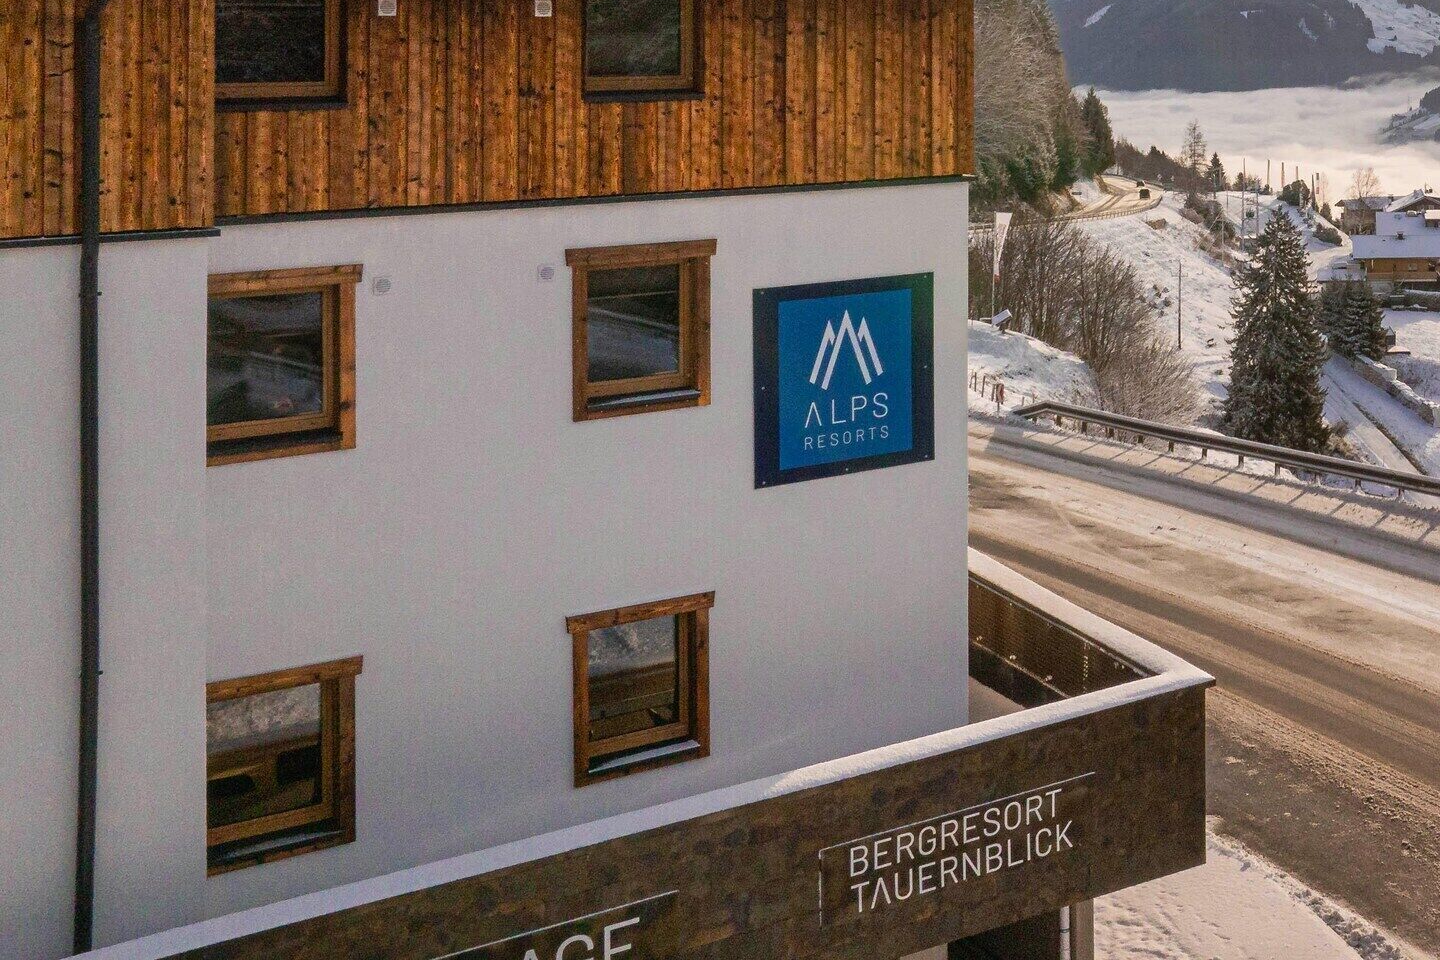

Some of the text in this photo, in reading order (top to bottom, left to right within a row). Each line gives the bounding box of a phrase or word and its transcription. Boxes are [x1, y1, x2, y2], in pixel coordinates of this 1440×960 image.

[804, 392, 888, 429] ALPS
[804, 425, 889, 451] RESORTS
[850, 788, 1062, 878] BERGRESORT
[851, 820, 1074, 913] TAUERNBLICK
